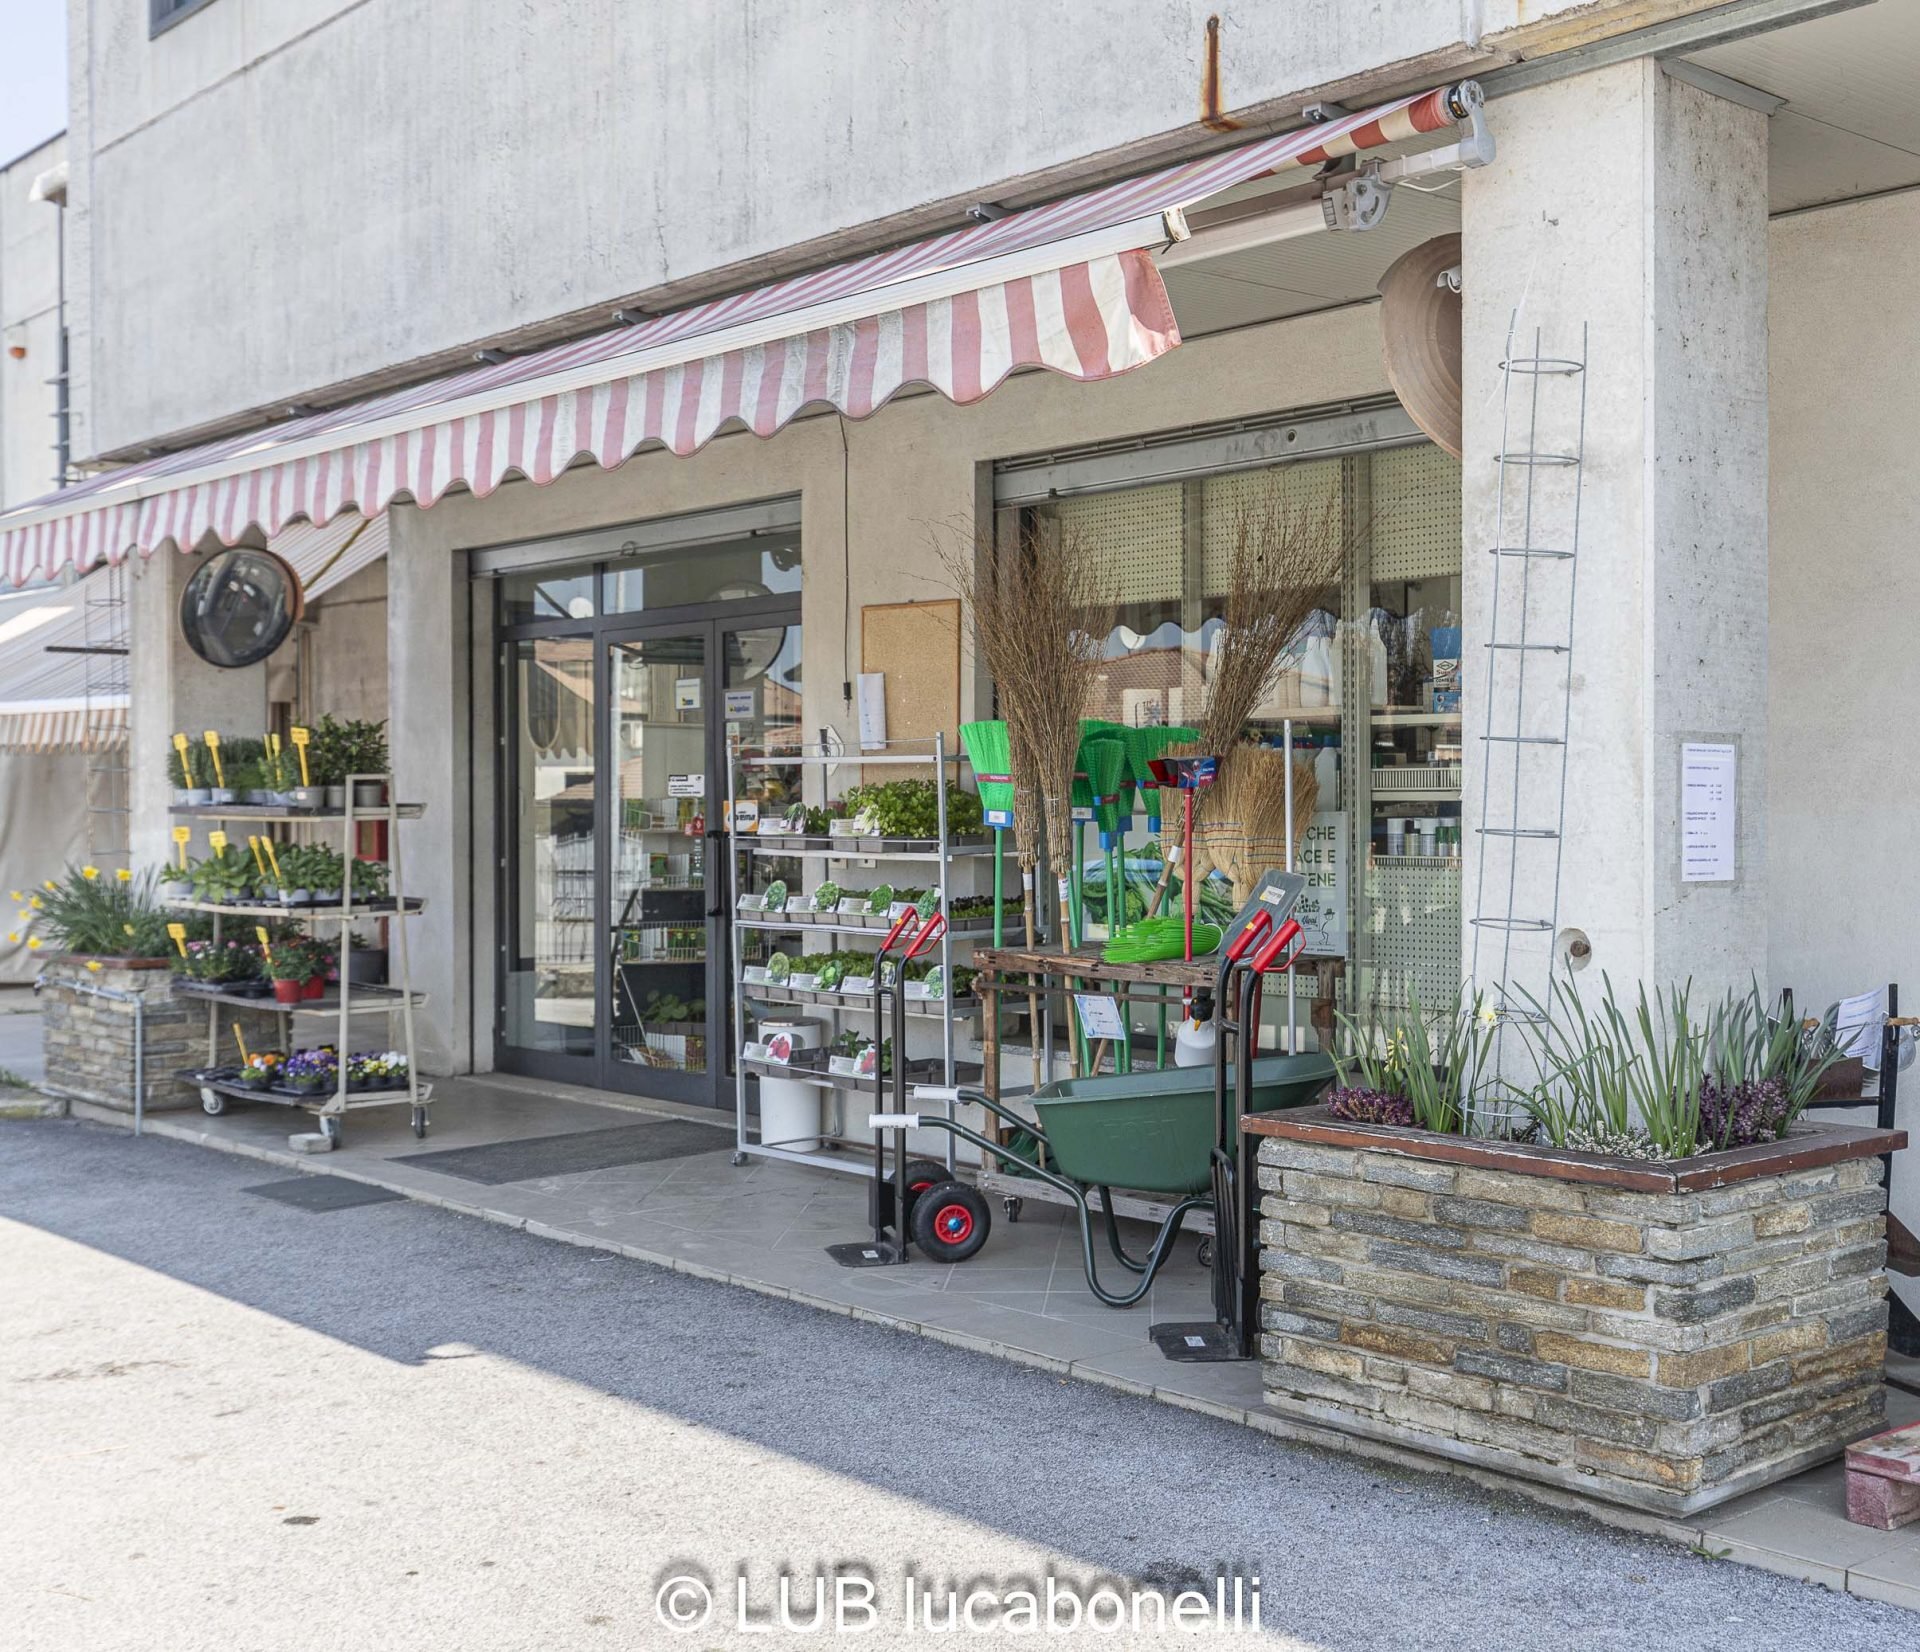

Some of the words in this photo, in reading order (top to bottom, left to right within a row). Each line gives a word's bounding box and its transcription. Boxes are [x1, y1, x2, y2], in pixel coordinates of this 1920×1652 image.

[1306, 825, 1336, 841] CHE
[1327, 849, 1336, 864] E
[1300, 872, 1336, 887] ENE
